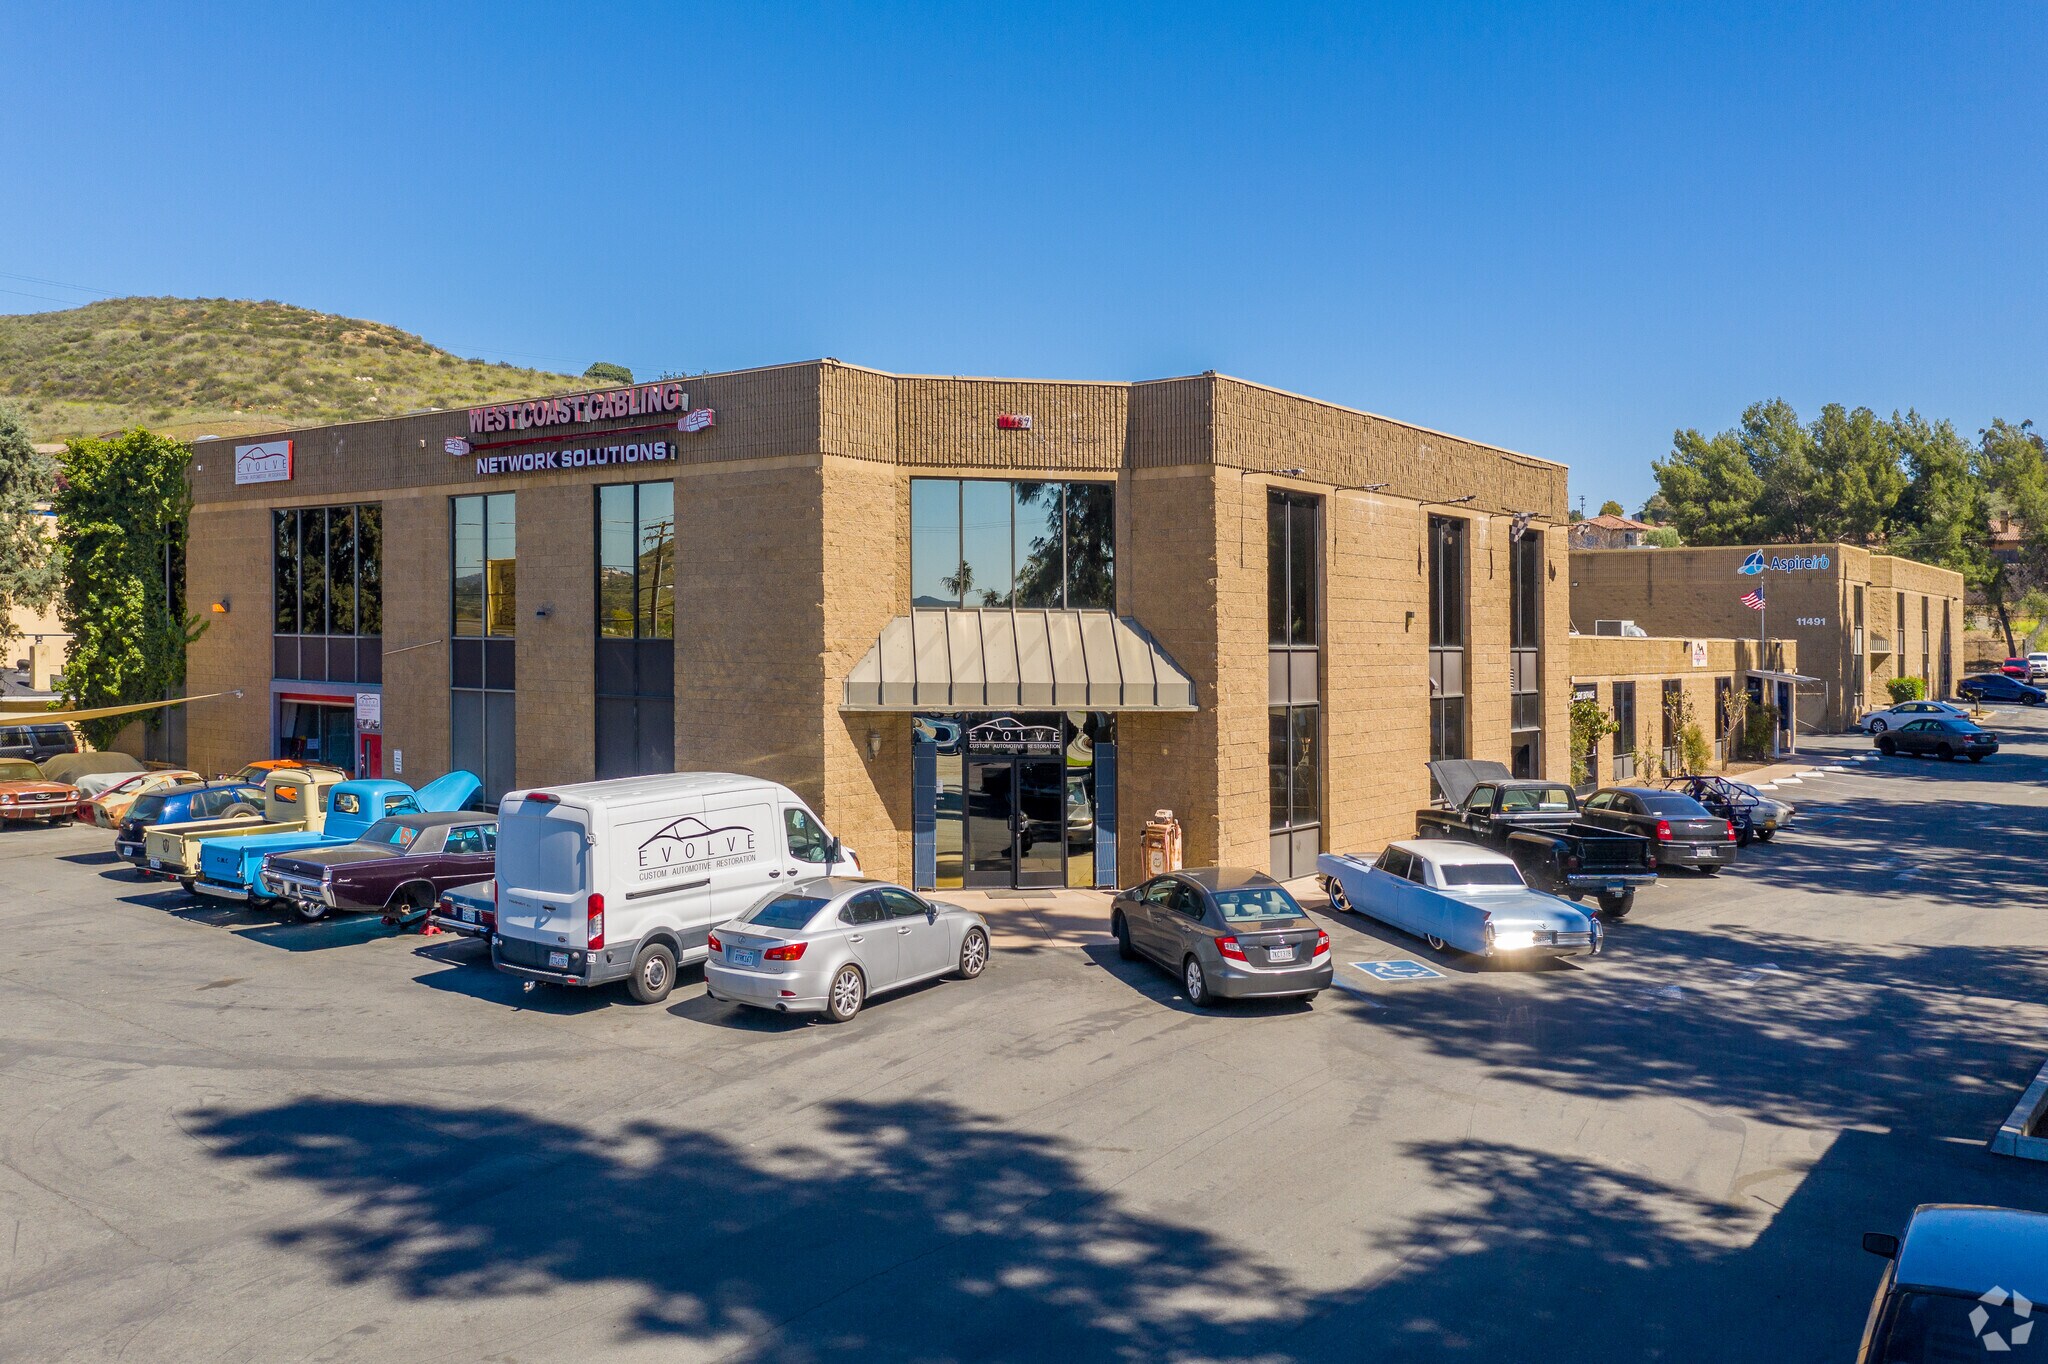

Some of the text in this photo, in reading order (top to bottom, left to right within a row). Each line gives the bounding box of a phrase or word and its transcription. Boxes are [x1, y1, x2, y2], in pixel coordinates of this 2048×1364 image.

[469, 385, 682, 433] WEST COAST CABLING
[238, 459, 287, 473] EVOLVE
[476, 441, 667, 475] NETWORK SOLUTIONS
[1796, 617, 1826, 626] 11491
[969, 731, 1060, 741] EVOLVE
[639, 833, 755, 866] EVOLVE
[639, 854, 756, 881] CUSTOM AUTOMOTIVE RESTORATION
